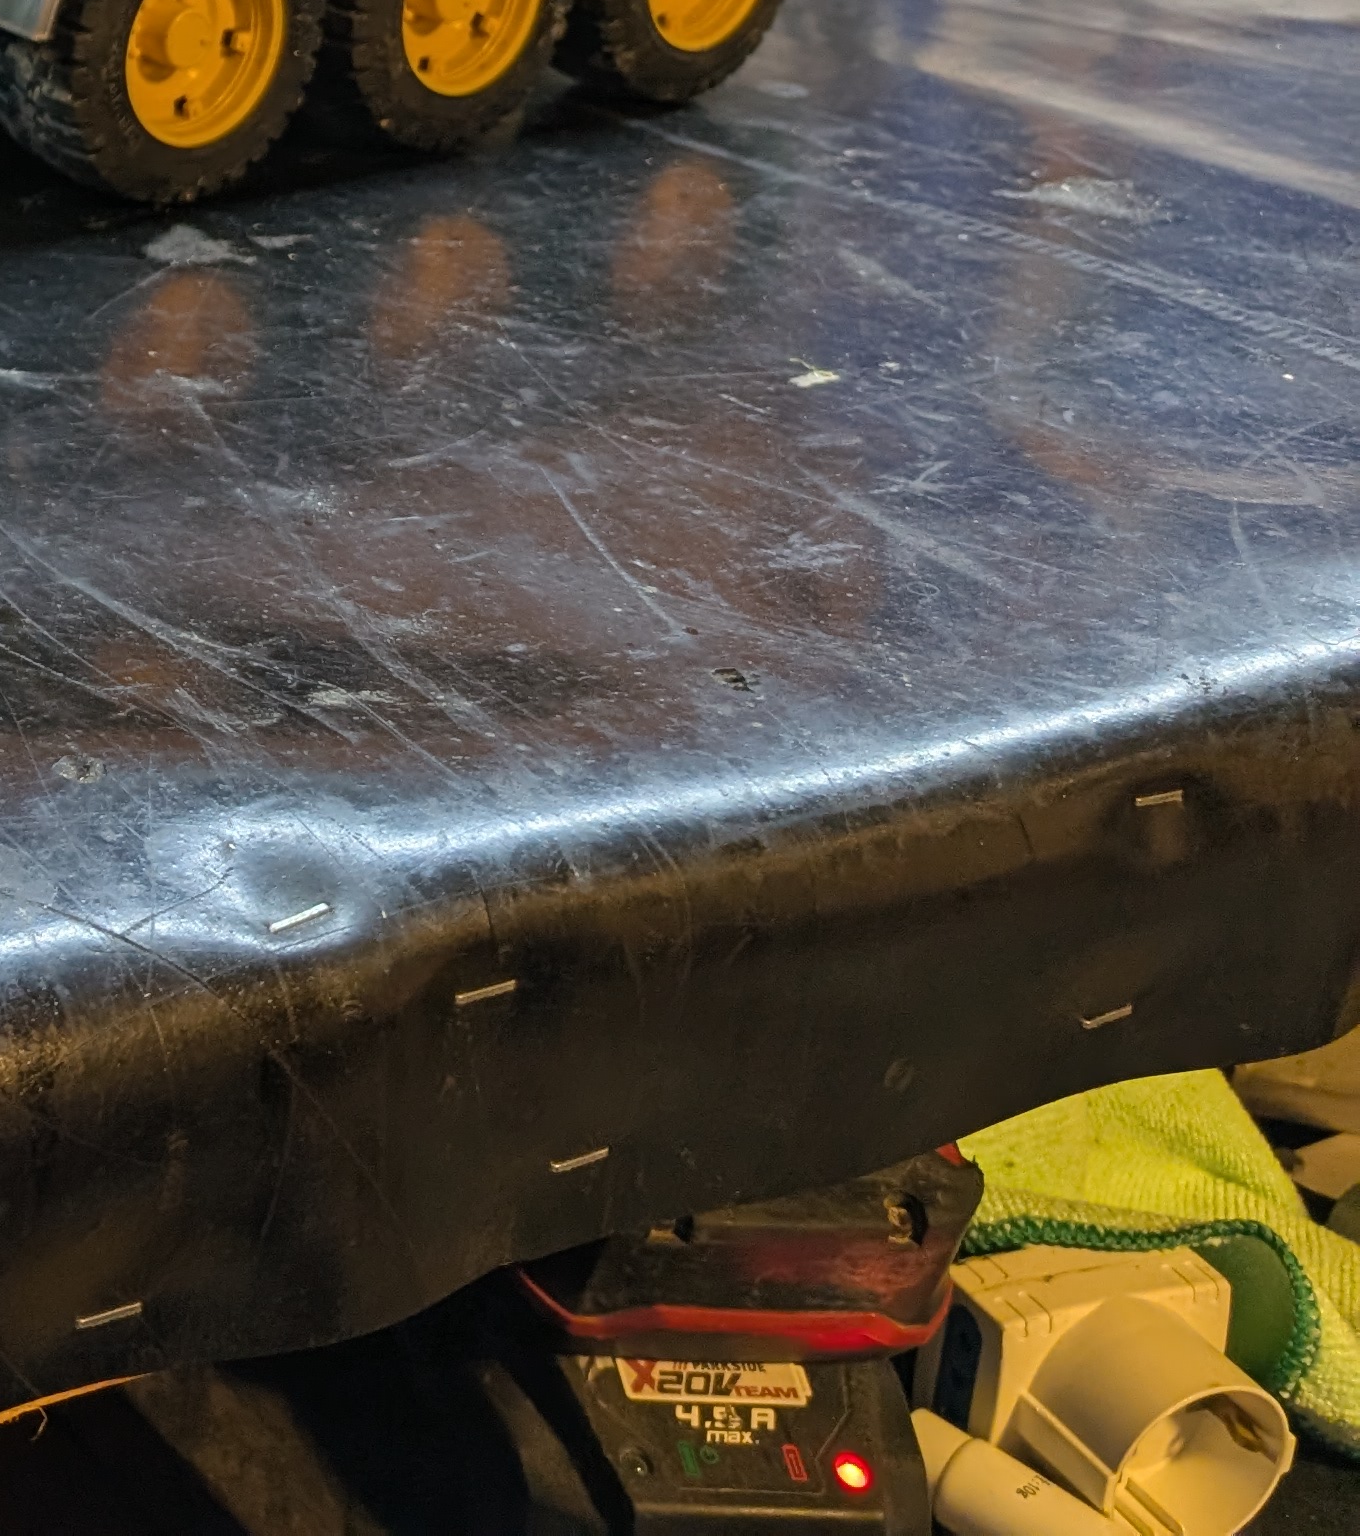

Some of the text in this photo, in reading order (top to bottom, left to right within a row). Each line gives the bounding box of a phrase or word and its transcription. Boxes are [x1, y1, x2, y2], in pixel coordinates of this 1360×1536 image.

[692, 1362, 767, 1374] PARKSIDE
[750, 1408, 777, 1431] A
[706, 1430, 760, 1445] max.
